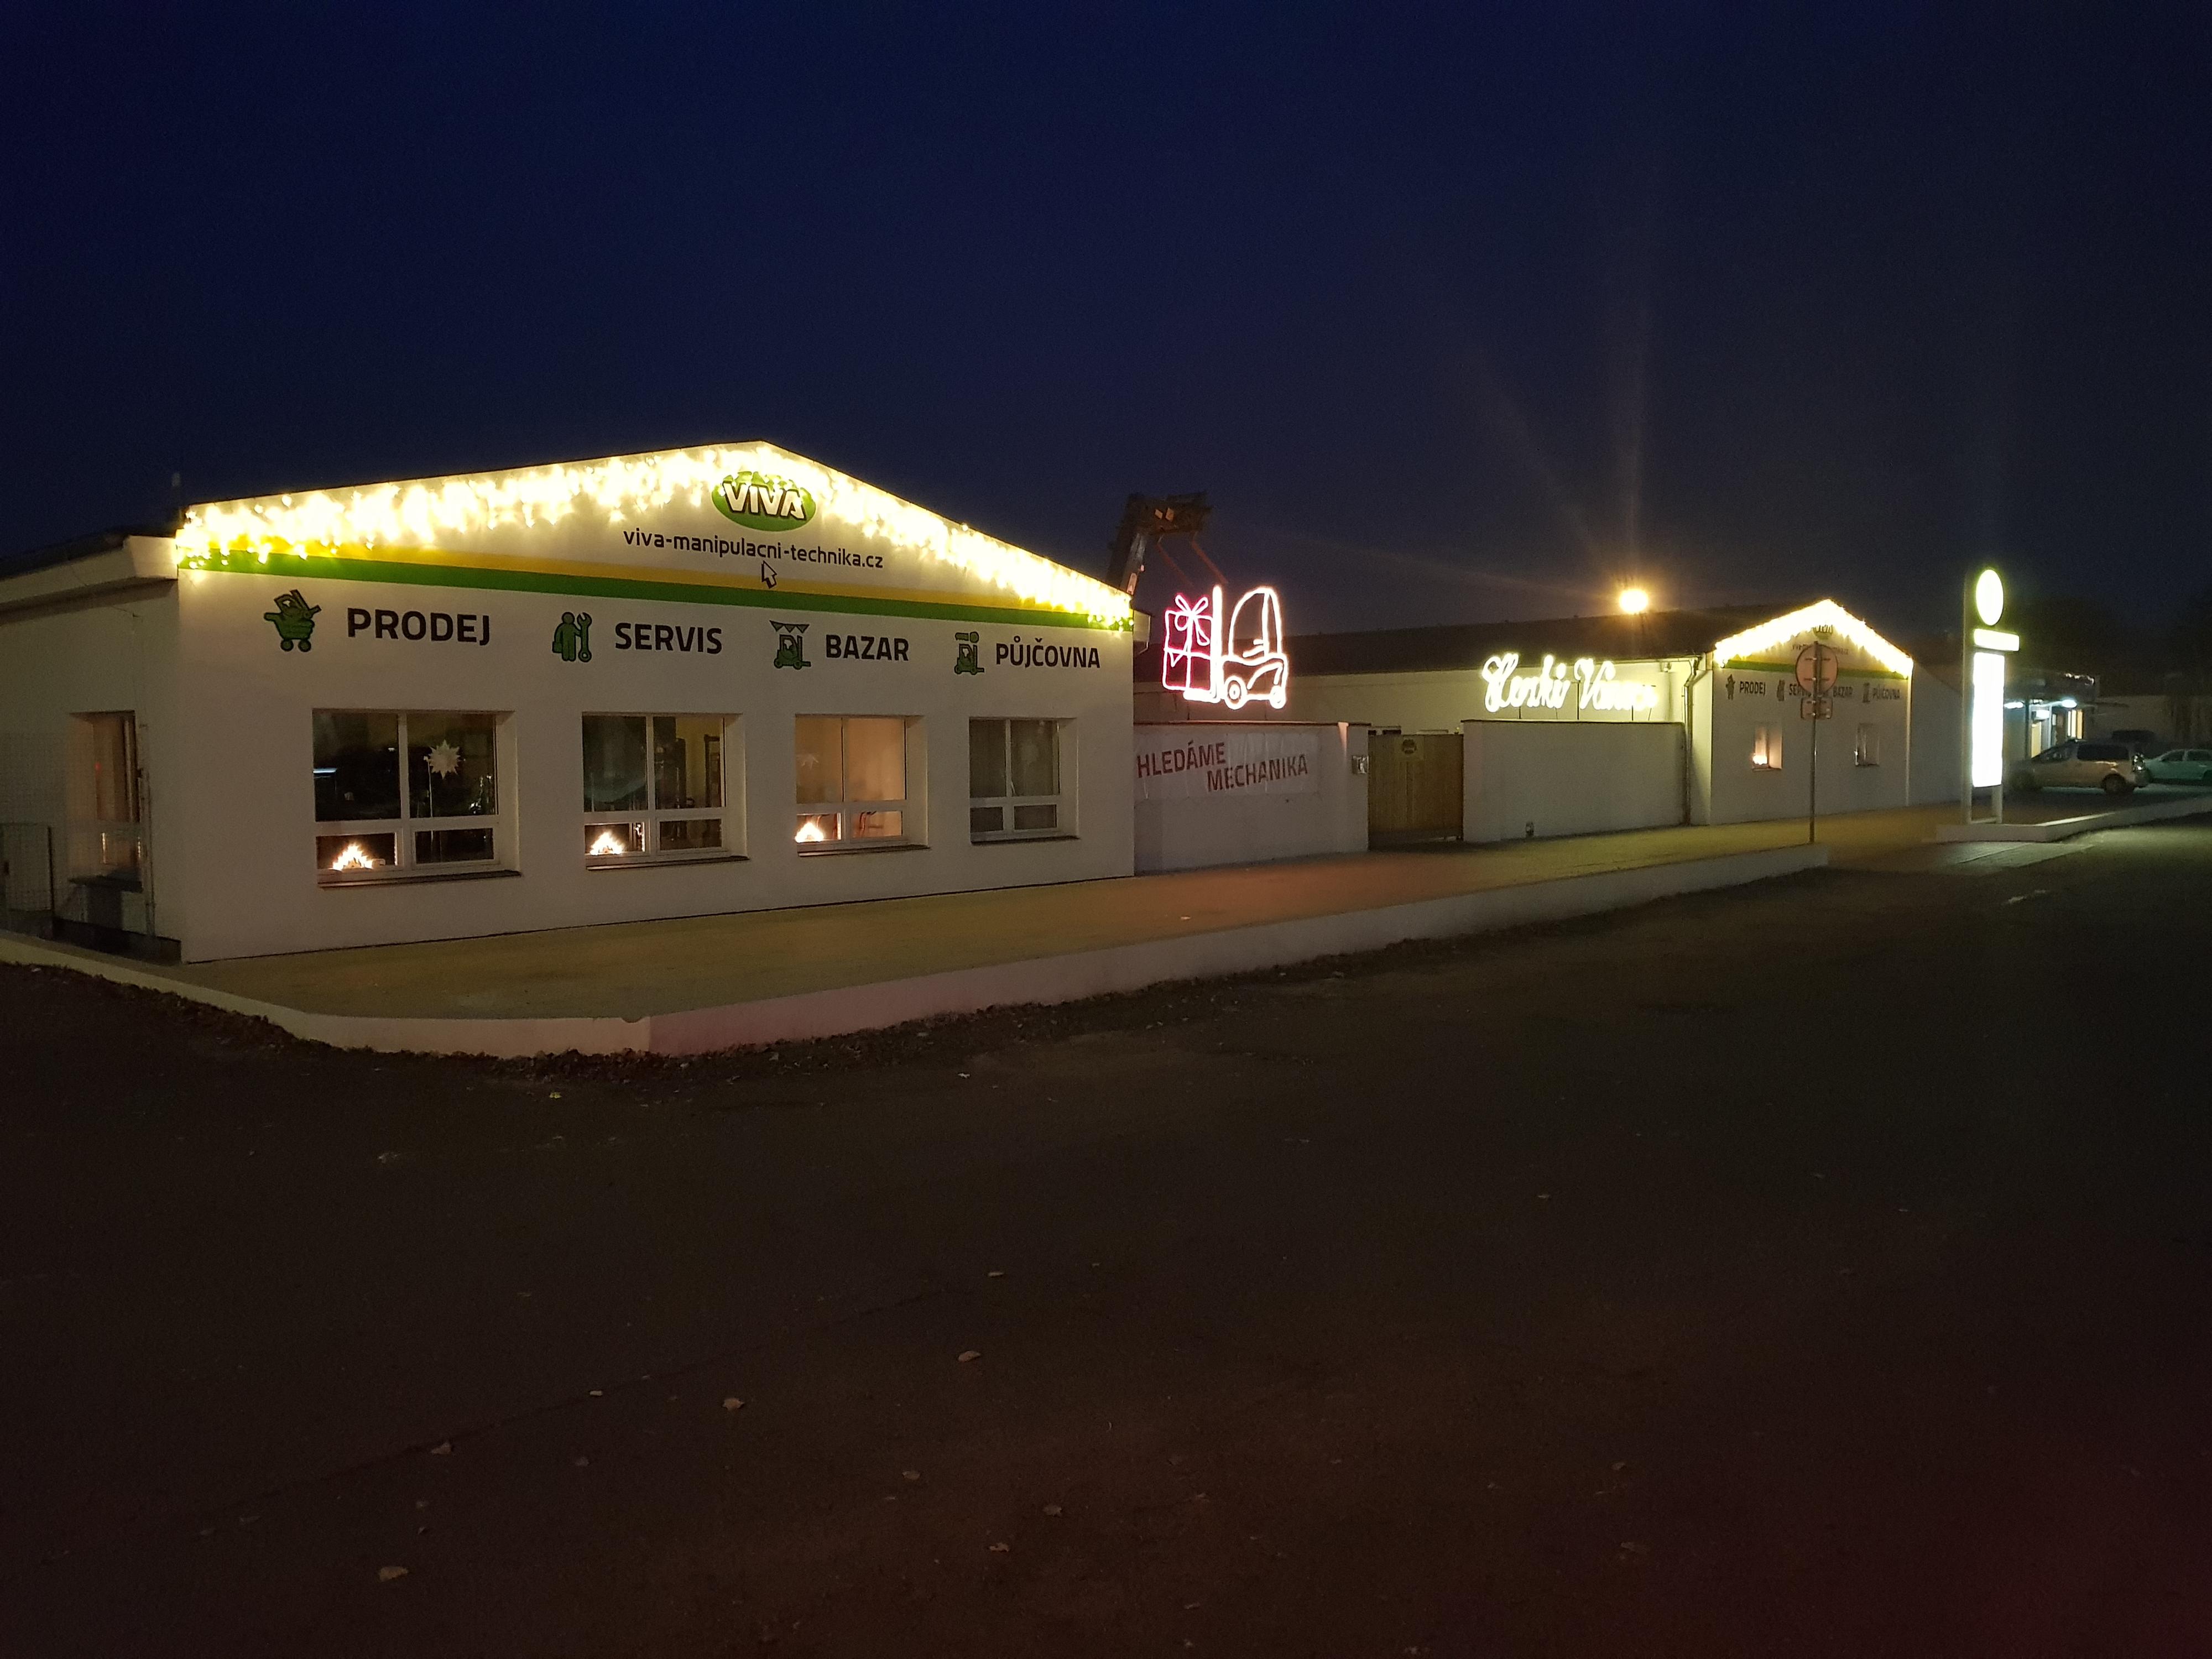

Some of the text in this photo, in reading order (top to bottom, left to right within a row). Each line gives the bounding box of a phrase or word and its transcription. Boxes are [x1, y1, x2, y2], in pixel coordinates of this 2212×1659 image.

[721, 480, 807, 520] VIVA
[623, 528, 884, 568] viva-manipulacni-technika.cz
[346, 607, 491, 646] PRODEJ
[614, 622, 723, 655] SERVIS
[825, 634, 909, 661] BAZAR
[995, 635, 1100, 669] PŮJČOVNA
[1739, 681, 1766, 697] PRODEJ
[1136, 740, 1226, 779] HLEDÁME
[1207, 754, 1308, 792] MECHANIKA
